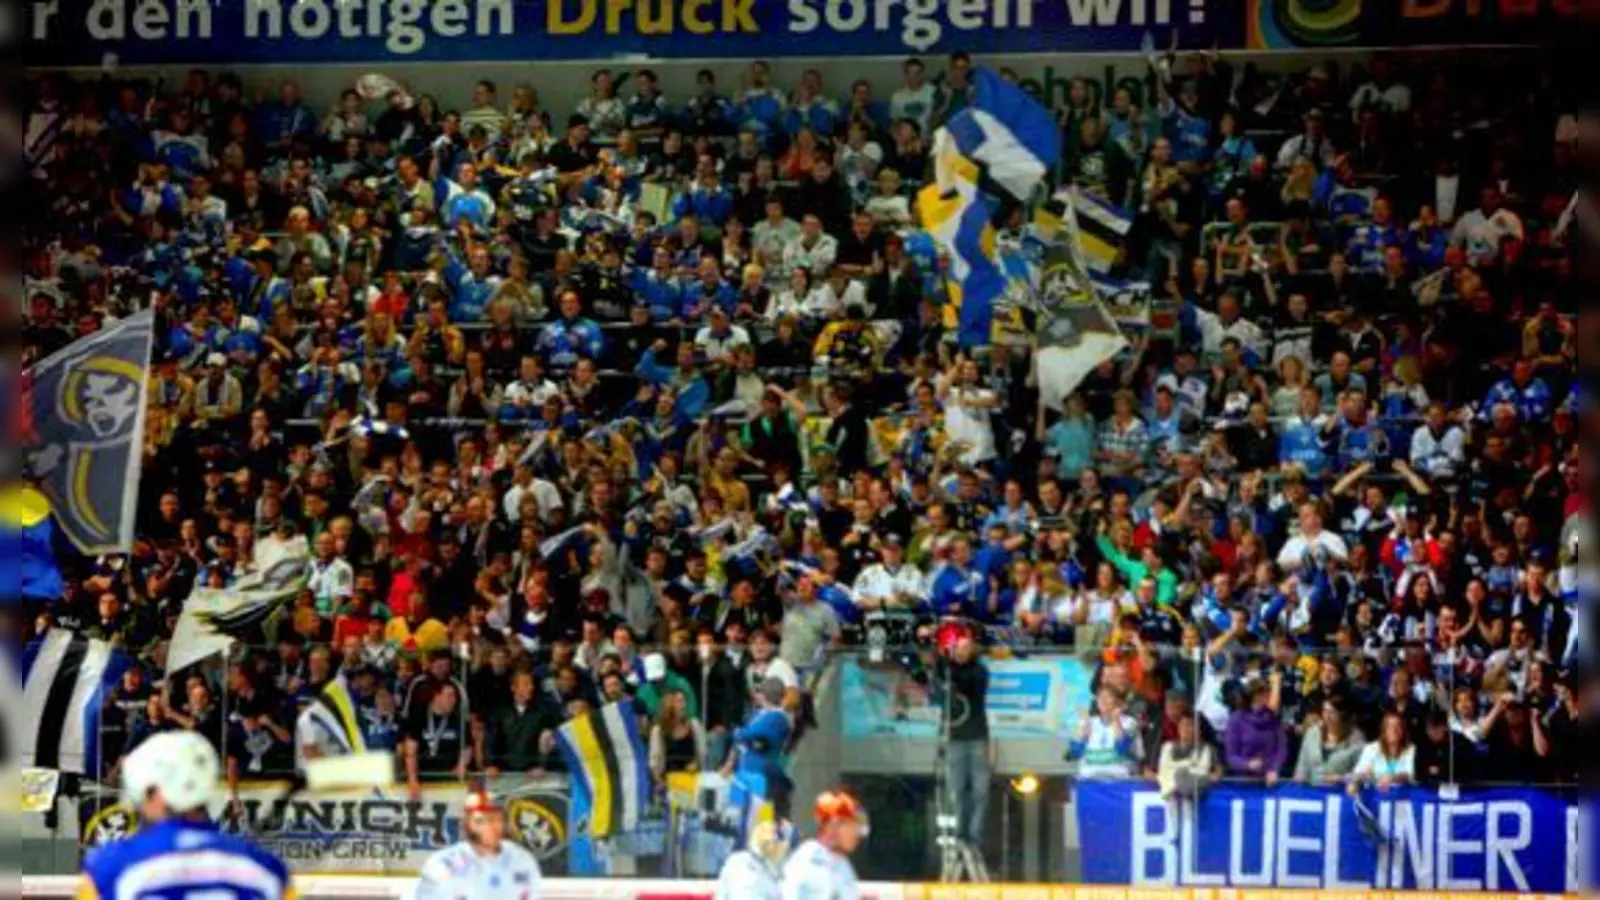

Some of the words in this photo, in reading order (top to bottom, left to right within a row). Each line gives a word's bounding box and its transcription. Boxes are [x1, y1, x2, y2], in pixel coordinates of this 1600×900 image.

[86, 0, 213, 40] den
[547, 0, 761, 34] Druck
[787, 0, 1031, 51] sorgen
[1131, 791, 1533, 891] BLUELINER
